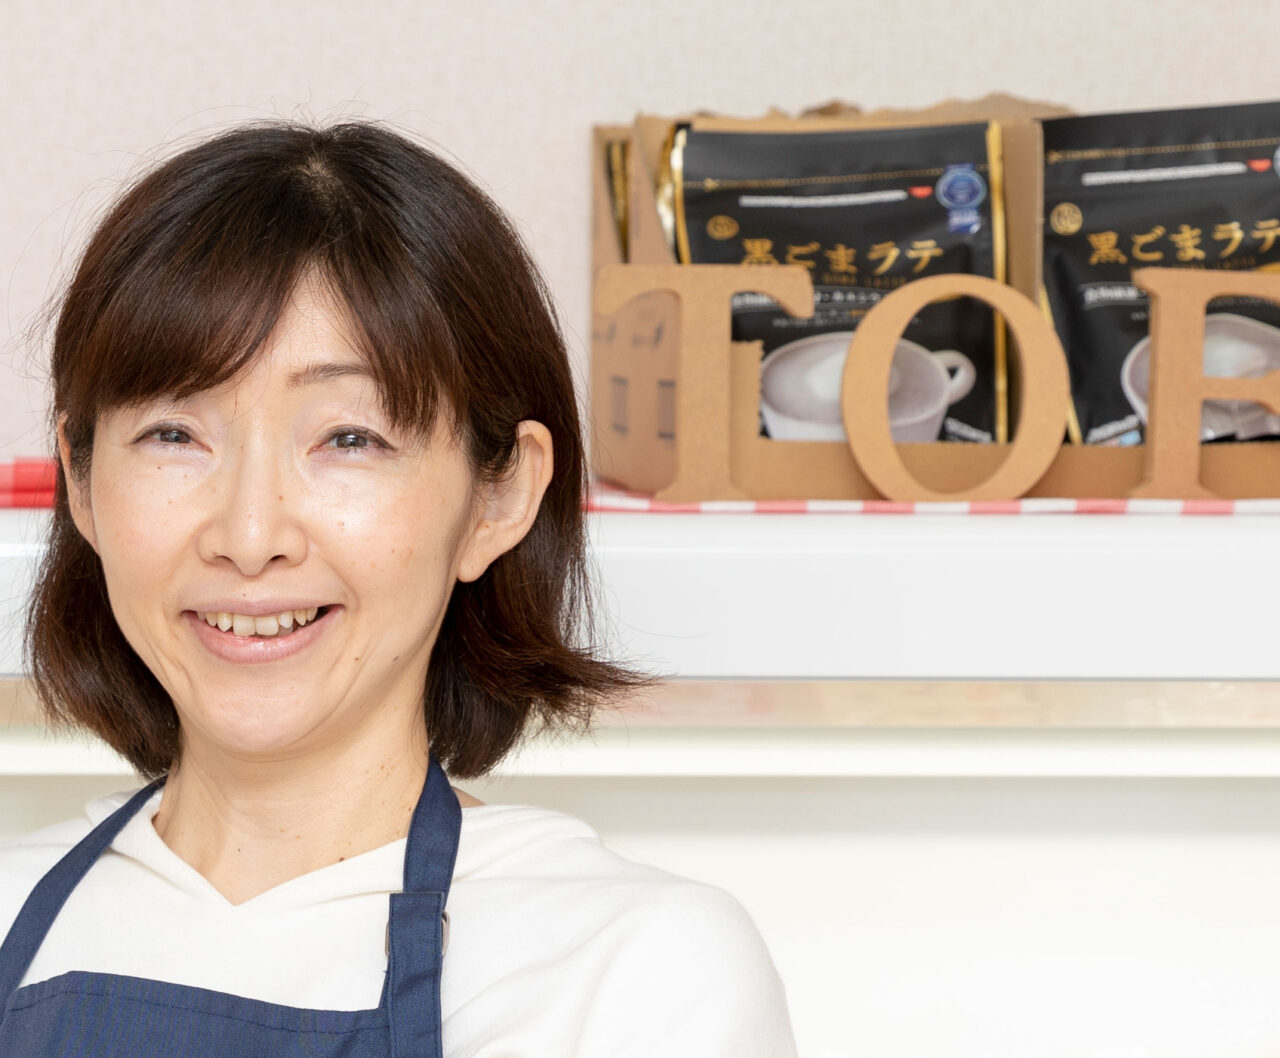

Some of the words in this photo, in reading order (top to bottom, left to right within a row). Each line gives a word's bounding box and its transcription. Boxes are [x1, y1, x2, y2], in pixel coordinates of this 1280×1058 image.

[742, 238, 944, 275] 黒ごまラテ
[1086, 218, 1280, 266] 黒ごまラテ
